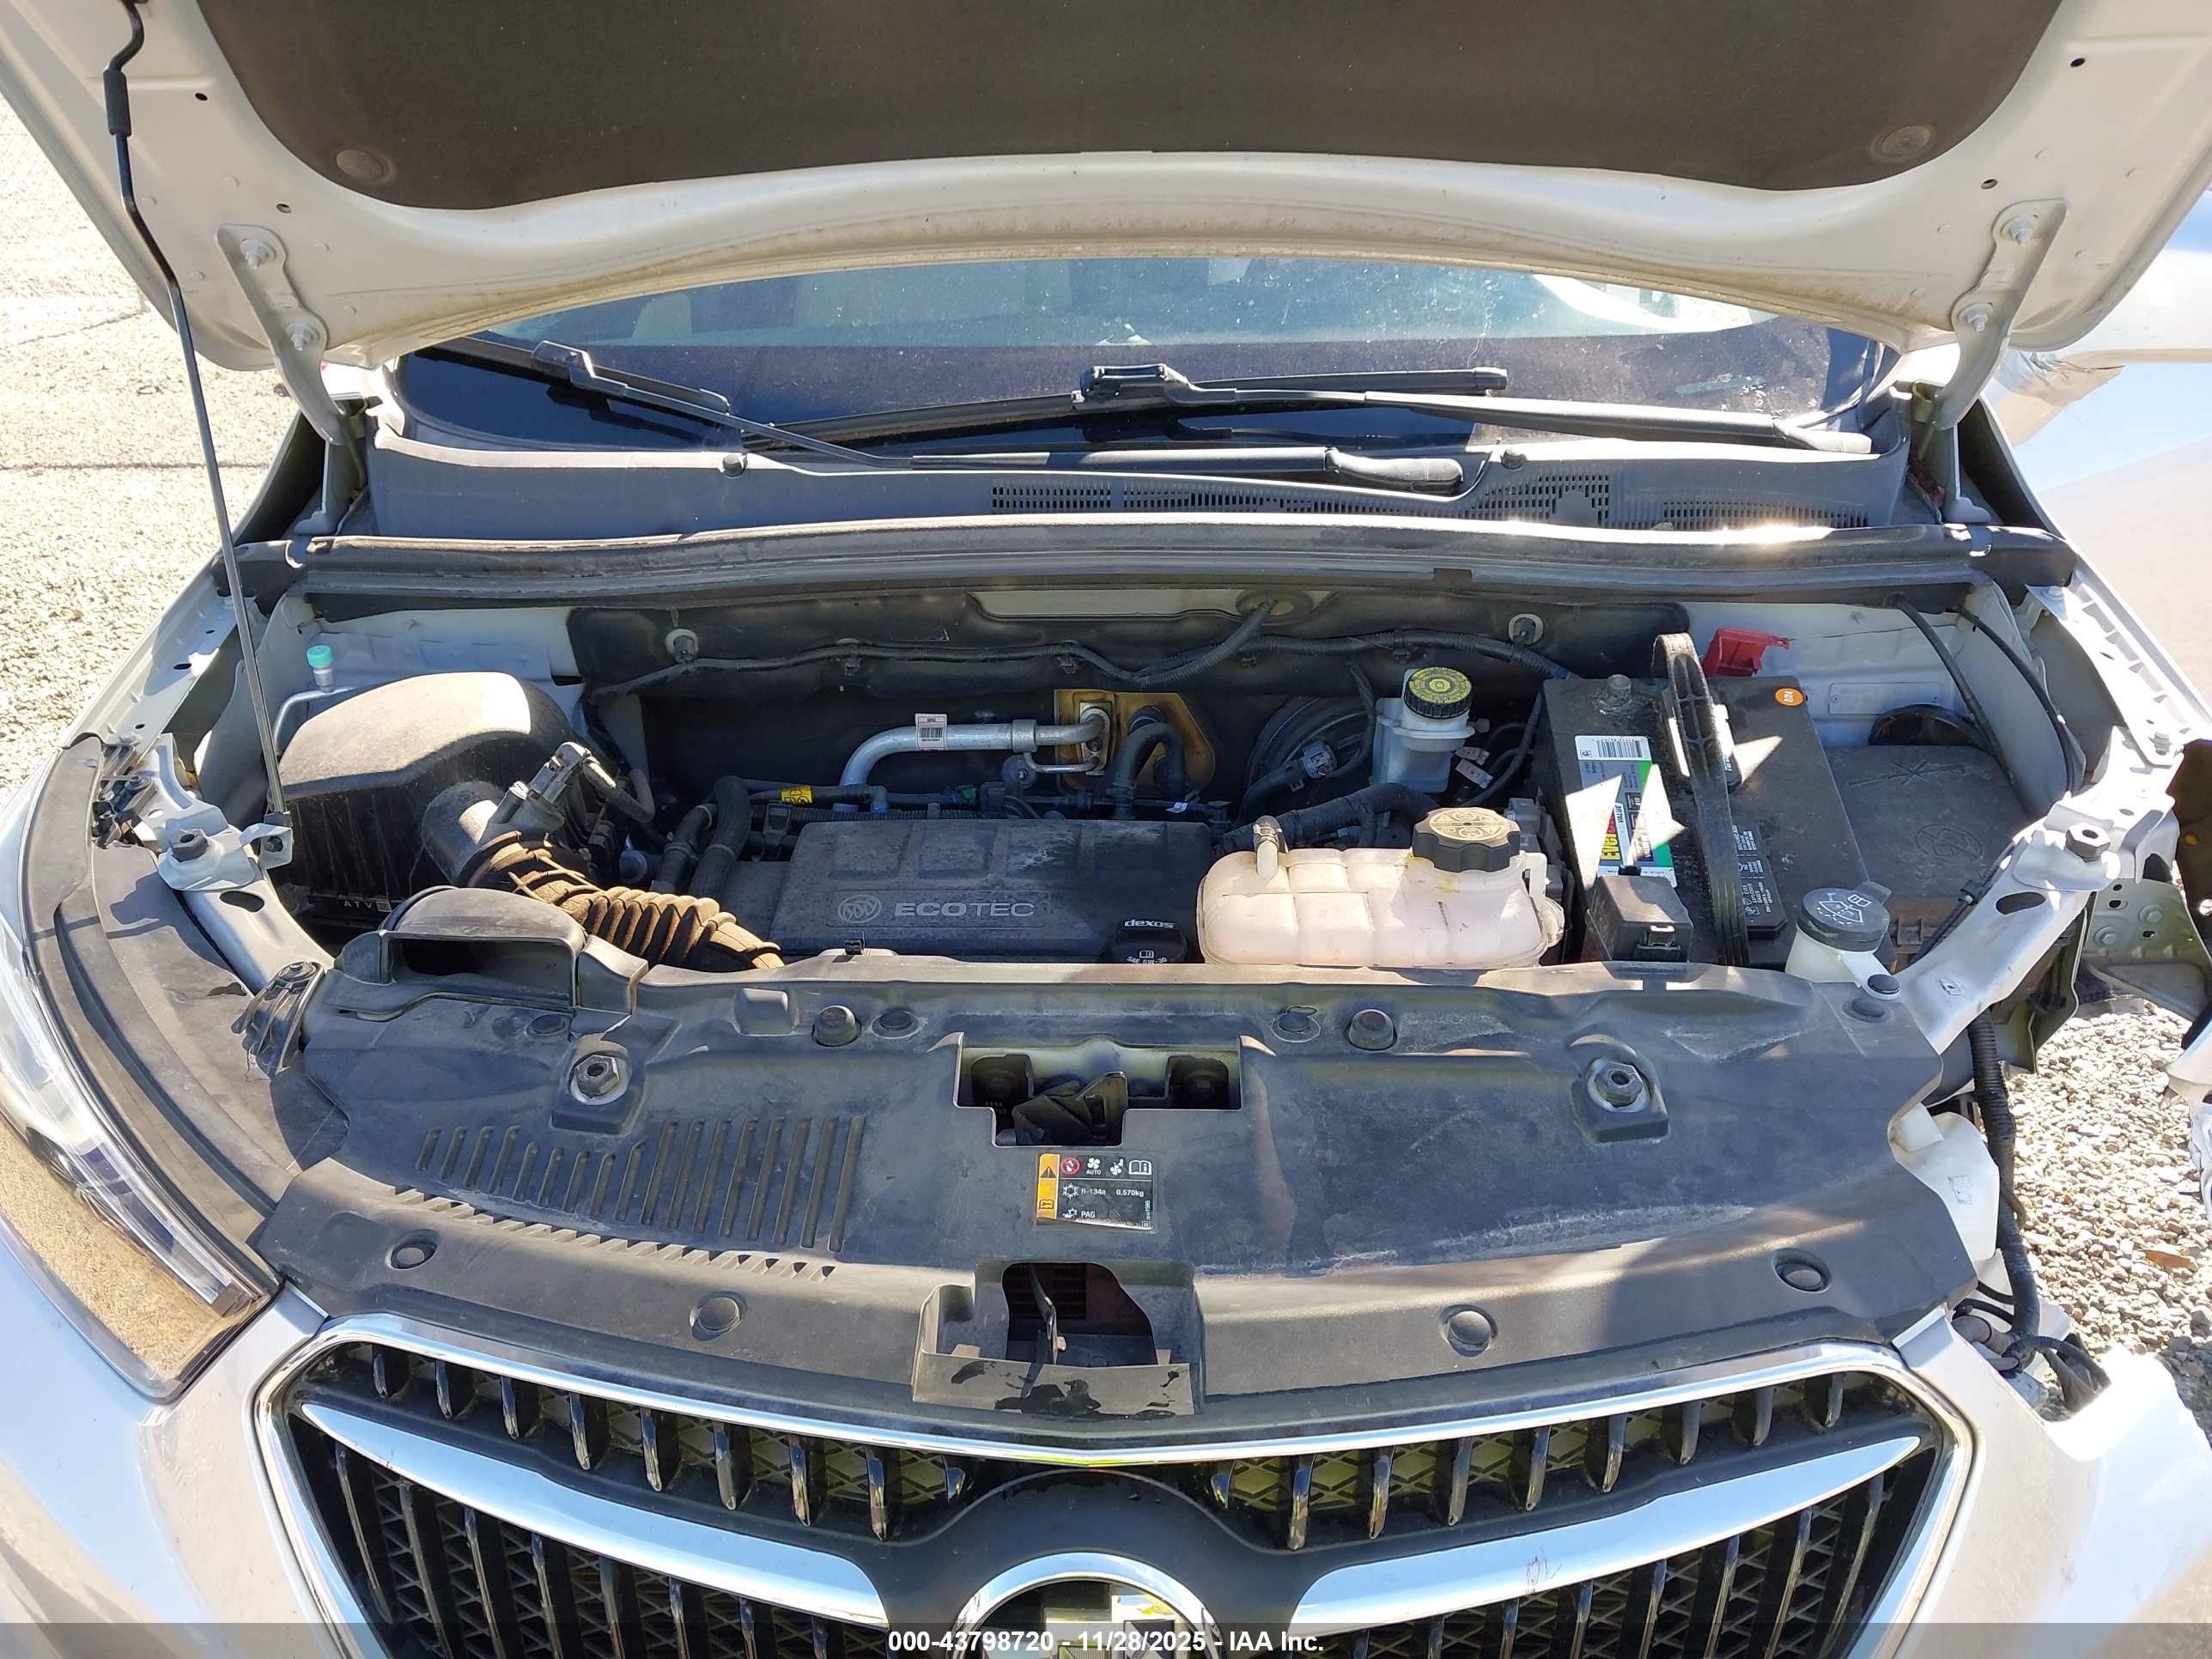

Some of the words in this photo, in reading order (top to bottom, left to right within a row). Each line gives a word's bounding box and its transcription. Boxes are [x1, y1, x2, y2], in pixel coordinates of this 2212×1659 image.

[1616, 804, 1625, 823] VALUE
[894, 902, 1036, 917] ECOTEC
[1124, 919, 1176, 928] dexos
[1115, 1188, 1145, 1198] 0.570kg
[1080, 1210, 1096, 1218] PAG
